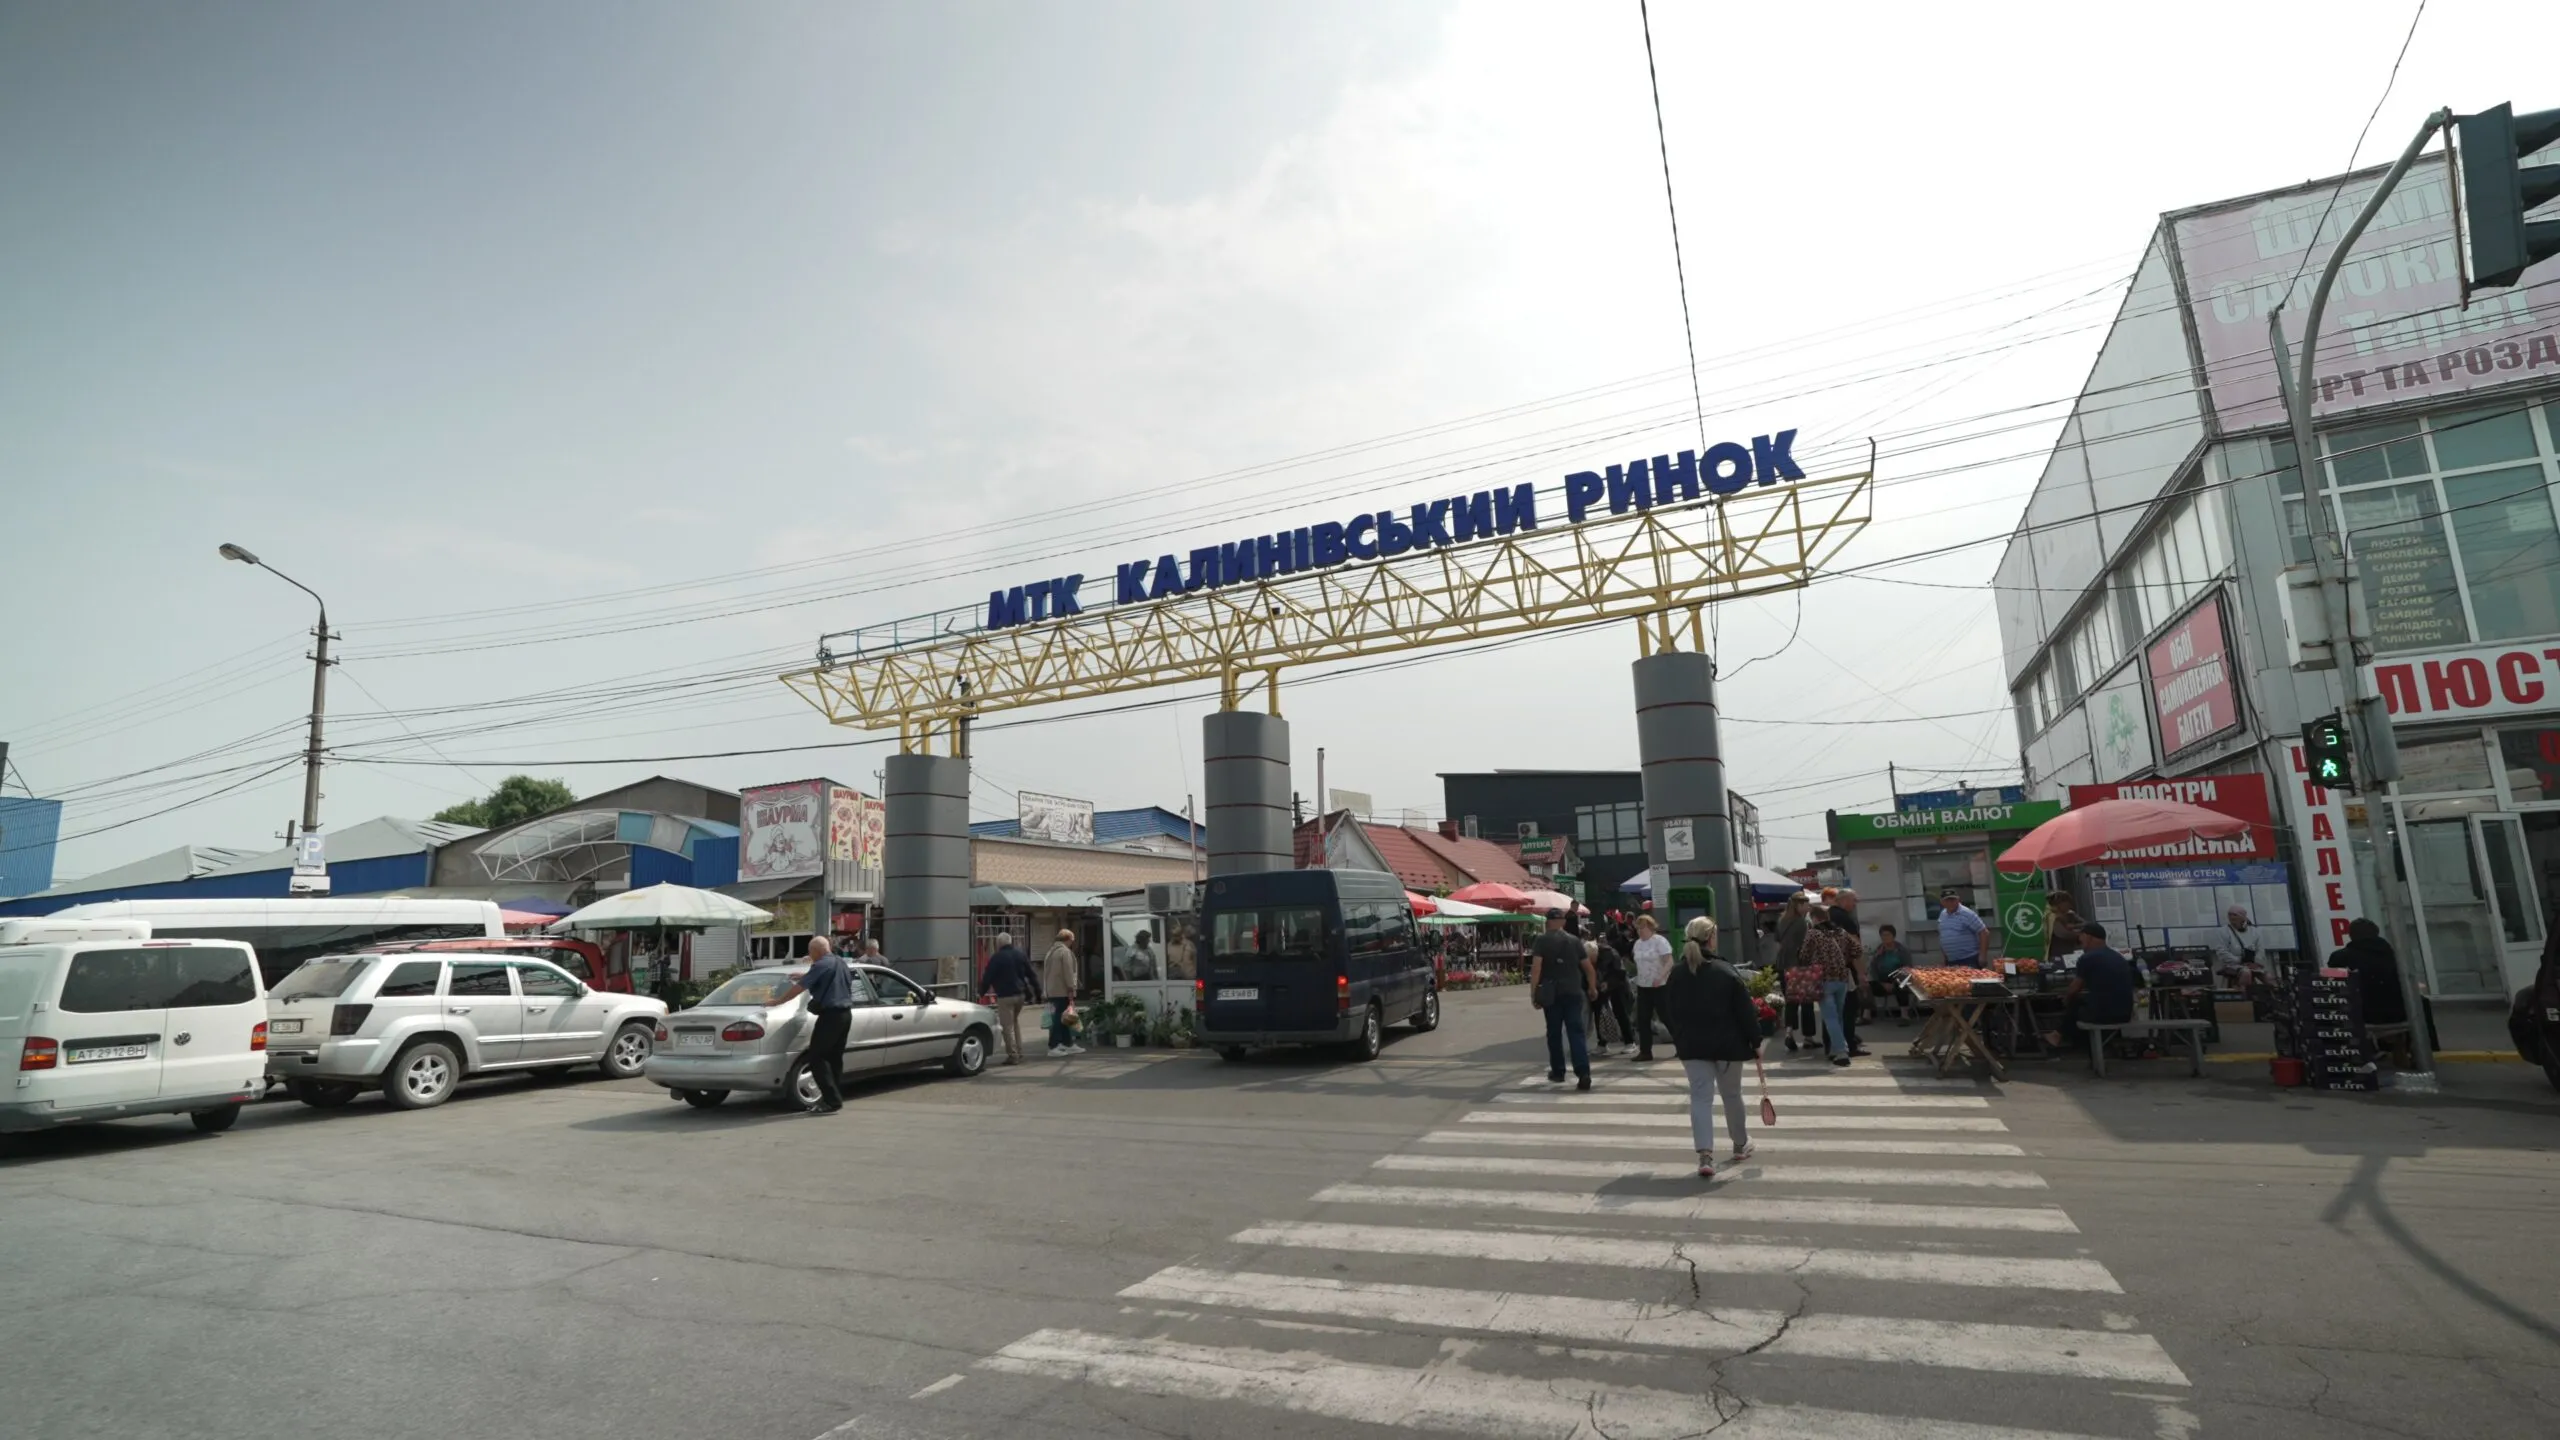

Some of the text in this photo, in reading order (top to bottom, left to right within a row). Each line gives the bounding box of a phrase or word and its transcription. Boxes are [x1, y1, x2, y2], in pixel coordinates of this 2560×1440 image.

[2374, 360, 2432, 391] ТА
[988, 573, 1084, 630] МТК
[1565, 428, 1806, 524] РИНОК
[2371, 536, 2422, 549] ЛЮСТРИ
[2382, 572, 2421, 585] ДЕКОР
[2380, 584, 2426, 596] РОЗЕТИ
[2379, 607, 2435, 620] САЙДИНГ
[2169, 624, 2194, 670] ОБОЇ
[2159, 652, 2225, 716] САМОКЛЕЙКА
[2176, 701, 2213, 745] БАГЕТИ
[833, 789, 858, 801] ШАУРМА
[757, 804, 808, 828] ШАУРМА
[1873, 805, 2013, 829] ОБМІН ВАЛЮТ
[303, 838, 322, 860] P
[1521, 841, 1551, 849] АПТЕКА
[2193, 867, 2226, 879] СТЕНД
[76, 1050, 94, 1060] AT
[125, 1047, 144, 1056] BH
